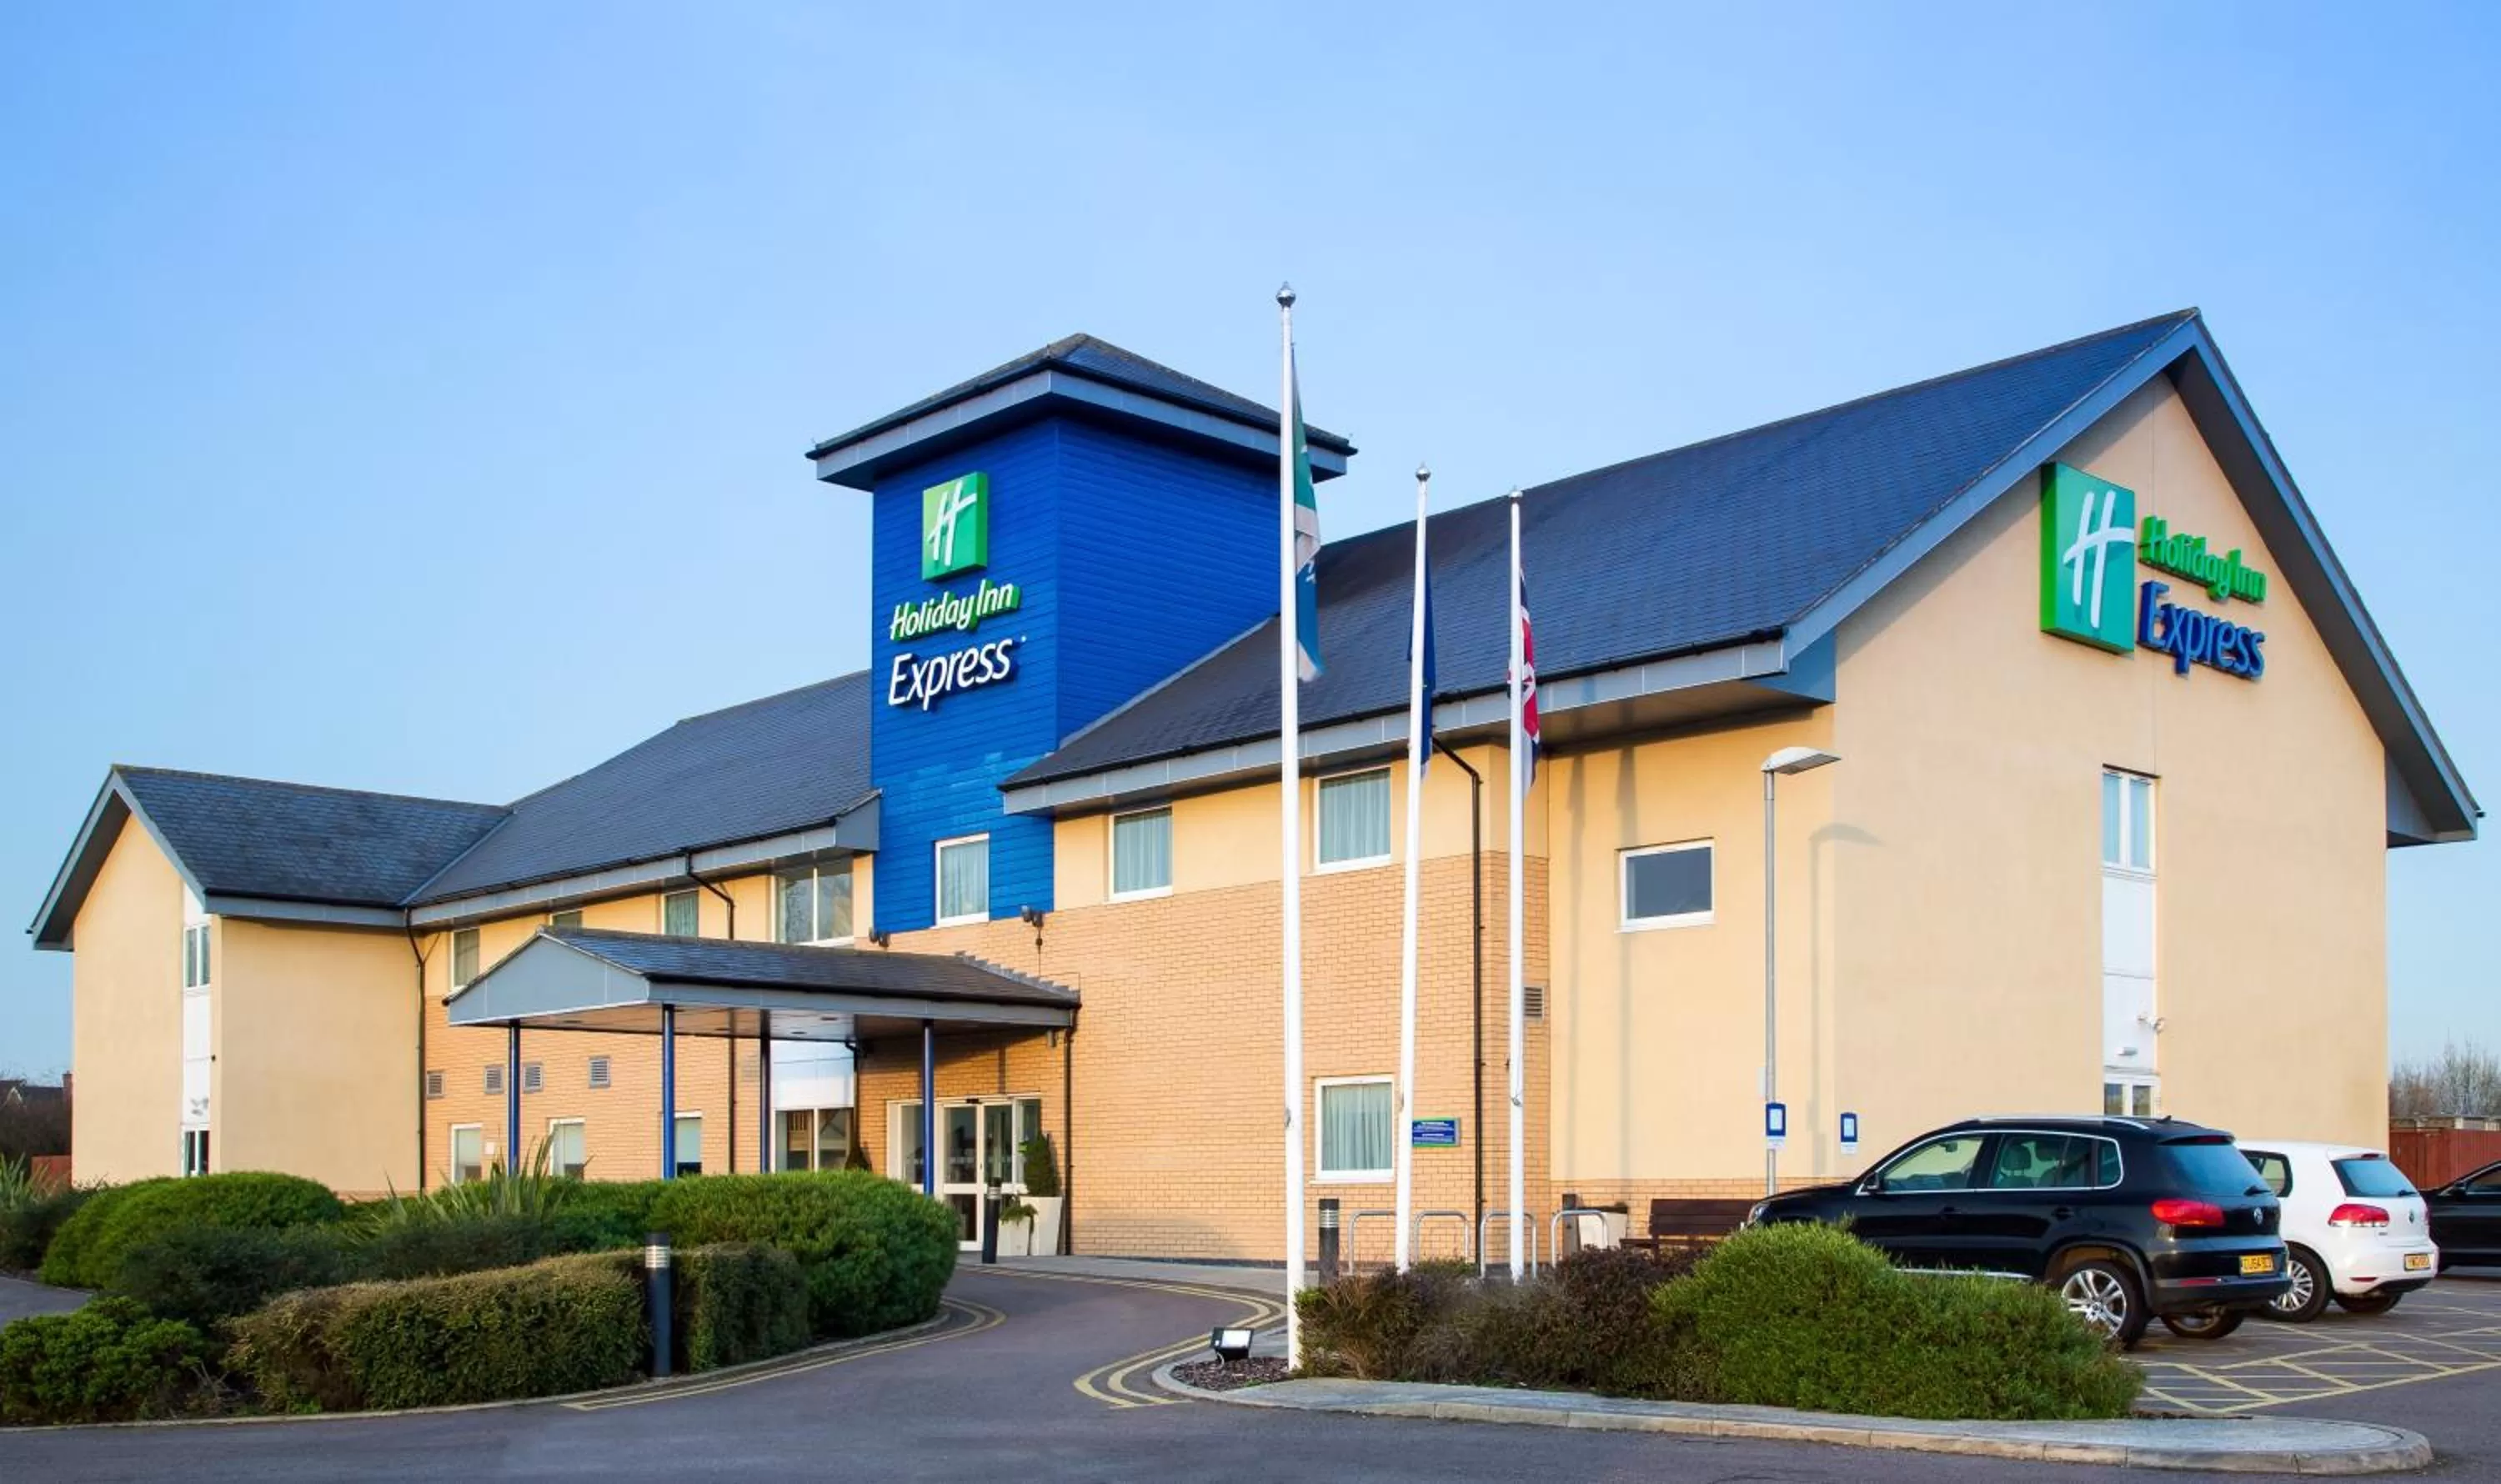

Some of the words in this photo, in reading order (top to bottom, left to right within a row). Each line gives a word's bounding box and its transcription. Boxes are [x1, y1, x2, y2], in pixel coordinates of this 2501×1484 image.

[926, 479, 977, 566] H
[2063, 489, 2134, 629] H
[2139, 515, 2231, 601] Holiday
[2228, 548, 2267, 604] Inn
[890, 590, 973, 640] Holiday
[976, 579, 1015, 615] Inn
[2138, 580, 2265, 679] Express
[888, 639, 1014, 710] Express
